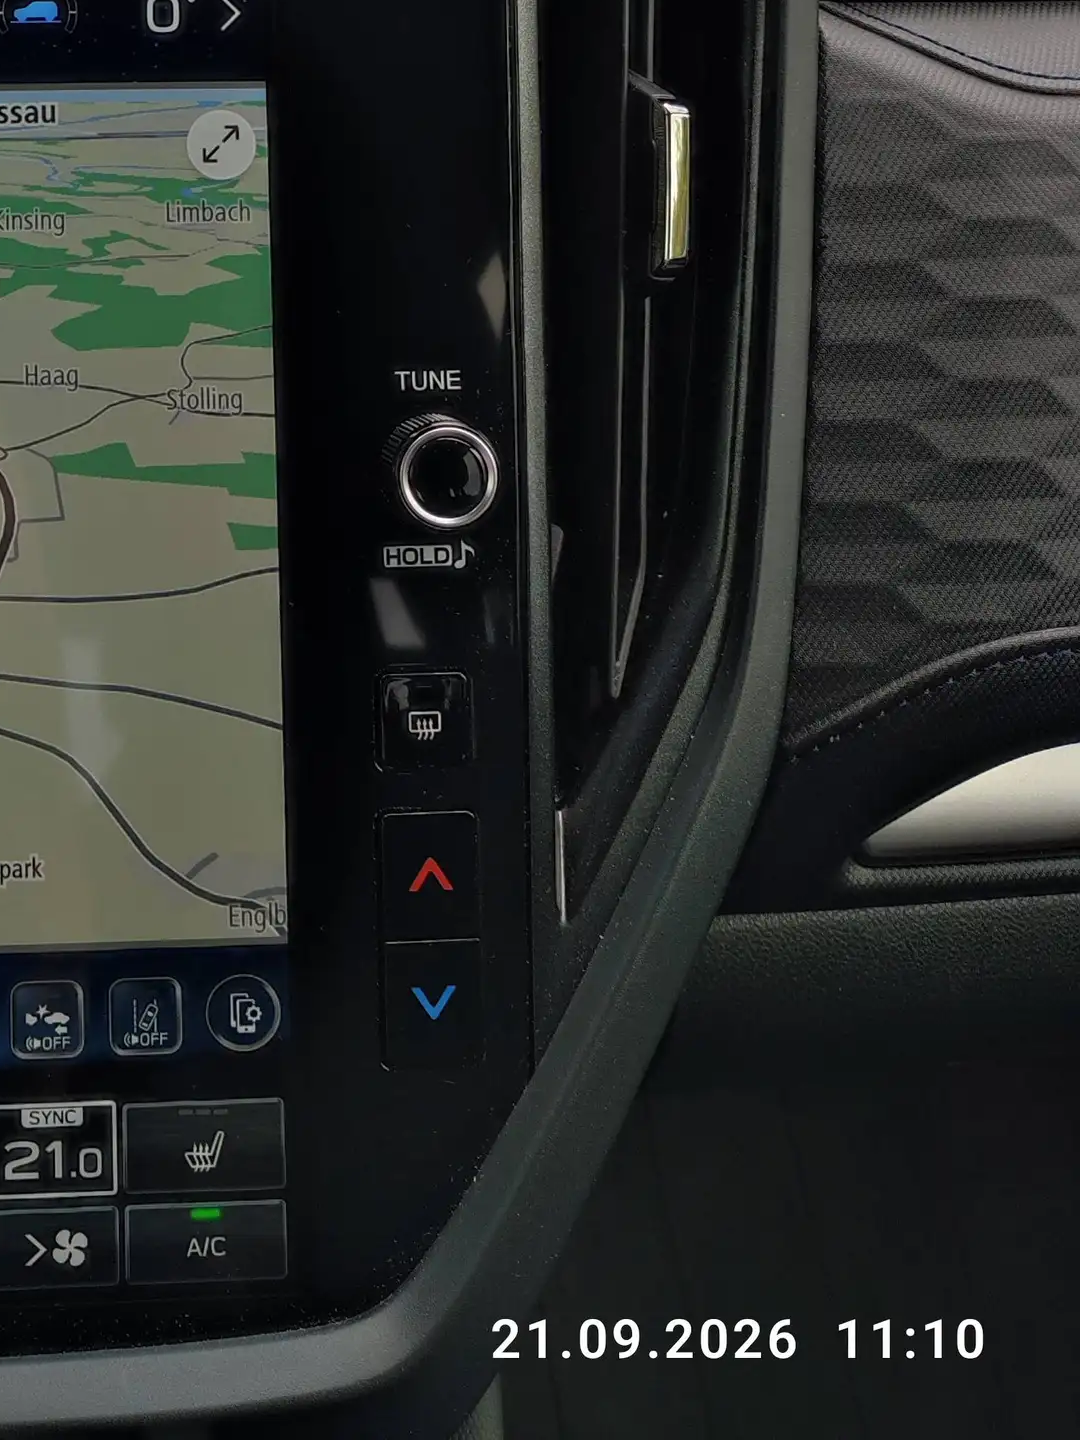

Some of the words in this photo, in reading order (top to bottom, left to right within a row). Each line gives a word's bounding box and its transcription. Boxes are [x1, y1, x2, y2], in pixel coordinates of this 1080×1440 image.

[166, 201, 251, 223] Limbach
[25, 366, 78, 389] Haag
[394, 370, 462, 391] TUNE
[167, 388, 243, 414] Stolling
[386, 547, 450, 565] HOLD
[230, 902, 286, 933] Englb
[42, 1036, 71, 1051] OFF
[140, 1032, 168, 1047] OFF
[29, 1110, 77, 1125] SYNC
[4, 1141, 102, 1180] 21.0
[187, 1237, 226, 1257] A/C
